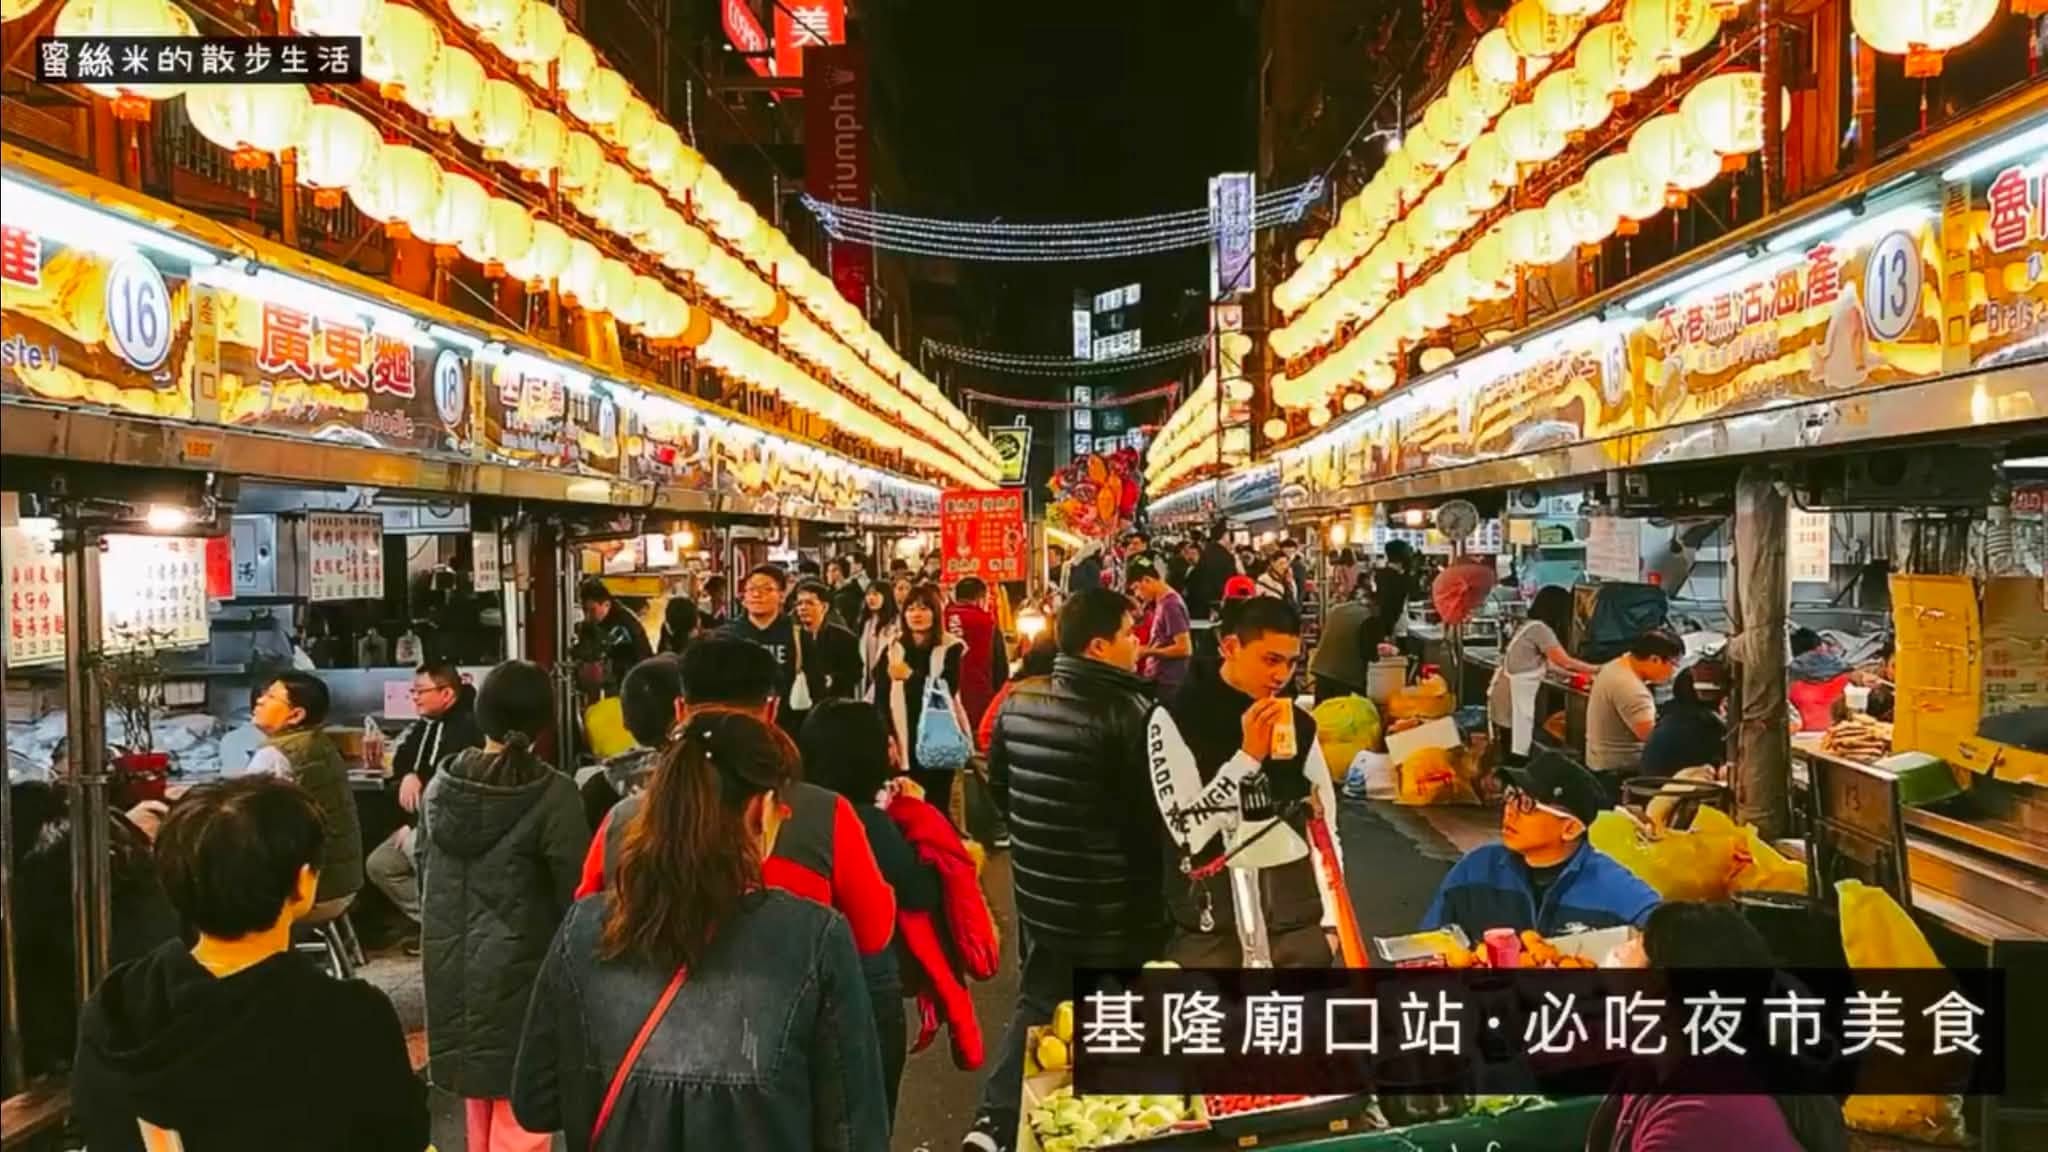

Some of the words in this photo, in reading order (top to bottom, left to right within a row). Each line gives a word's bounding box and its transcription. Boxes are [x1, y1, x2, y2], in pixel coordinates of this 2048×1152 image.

[790, 4, 832, 48] 美
[122, 277, 158, 348] 16
[1878, 247, 1909, 321] 13
[257, 300, 417, 399] 廣東麵
[440, 367, 460, 419] 18
[1149, 723, 1175, 801] GRADE
